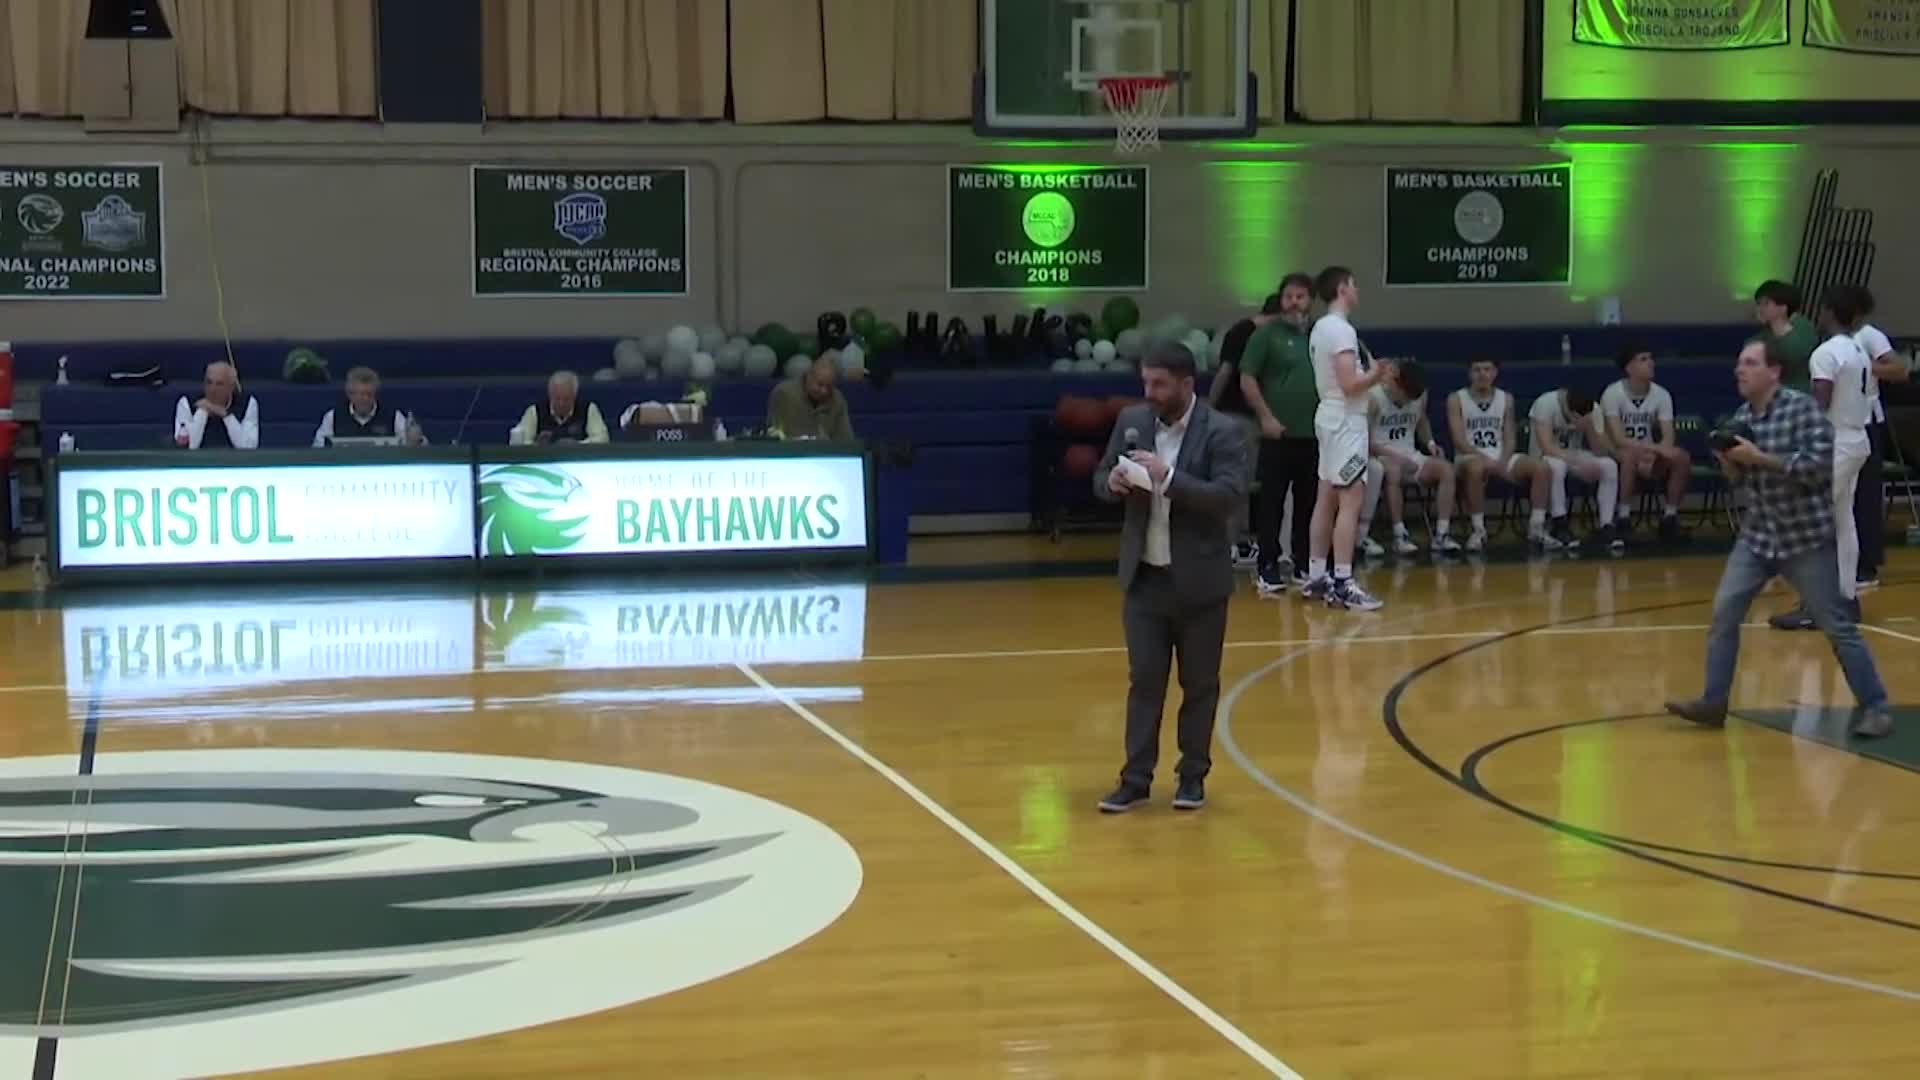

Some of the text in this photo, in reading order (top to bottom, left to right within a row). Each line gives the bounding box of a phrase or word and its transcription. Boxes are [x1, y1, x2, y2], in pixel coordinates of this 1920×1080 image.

[54, 171, 141, 188] SOCCER
[507, 174, 652, 191] MEN'S SOCCER
[958, 173, 1137, 189] MEN'S BASKETBALL
[1394, 172, 1562, 189] MEN'S BASKETBALL
[503, 248, 658, 258] BRISTOL COMMUNITY COLLEGE
[995, 250, 1103, 265] CHAMPIONS
[1427, 247, 1529, 262] CHAMPIONS
[41, 258, 157, 272] CHAMPIONS
[480, 258, 681, 273] REGIONAL CHAMPIONS
[1457, 263, 1498, 279] 2019
[24, 274, 71, 290] 2022
[561, 274, 602, 289] 2016
[1027, 267, 1070, 282] 2018
[656, 428, 684, 441] POSS
[77, 484, 293, 549] BRISTOL
[617, 493, 840, 544] BAYHAWKS
